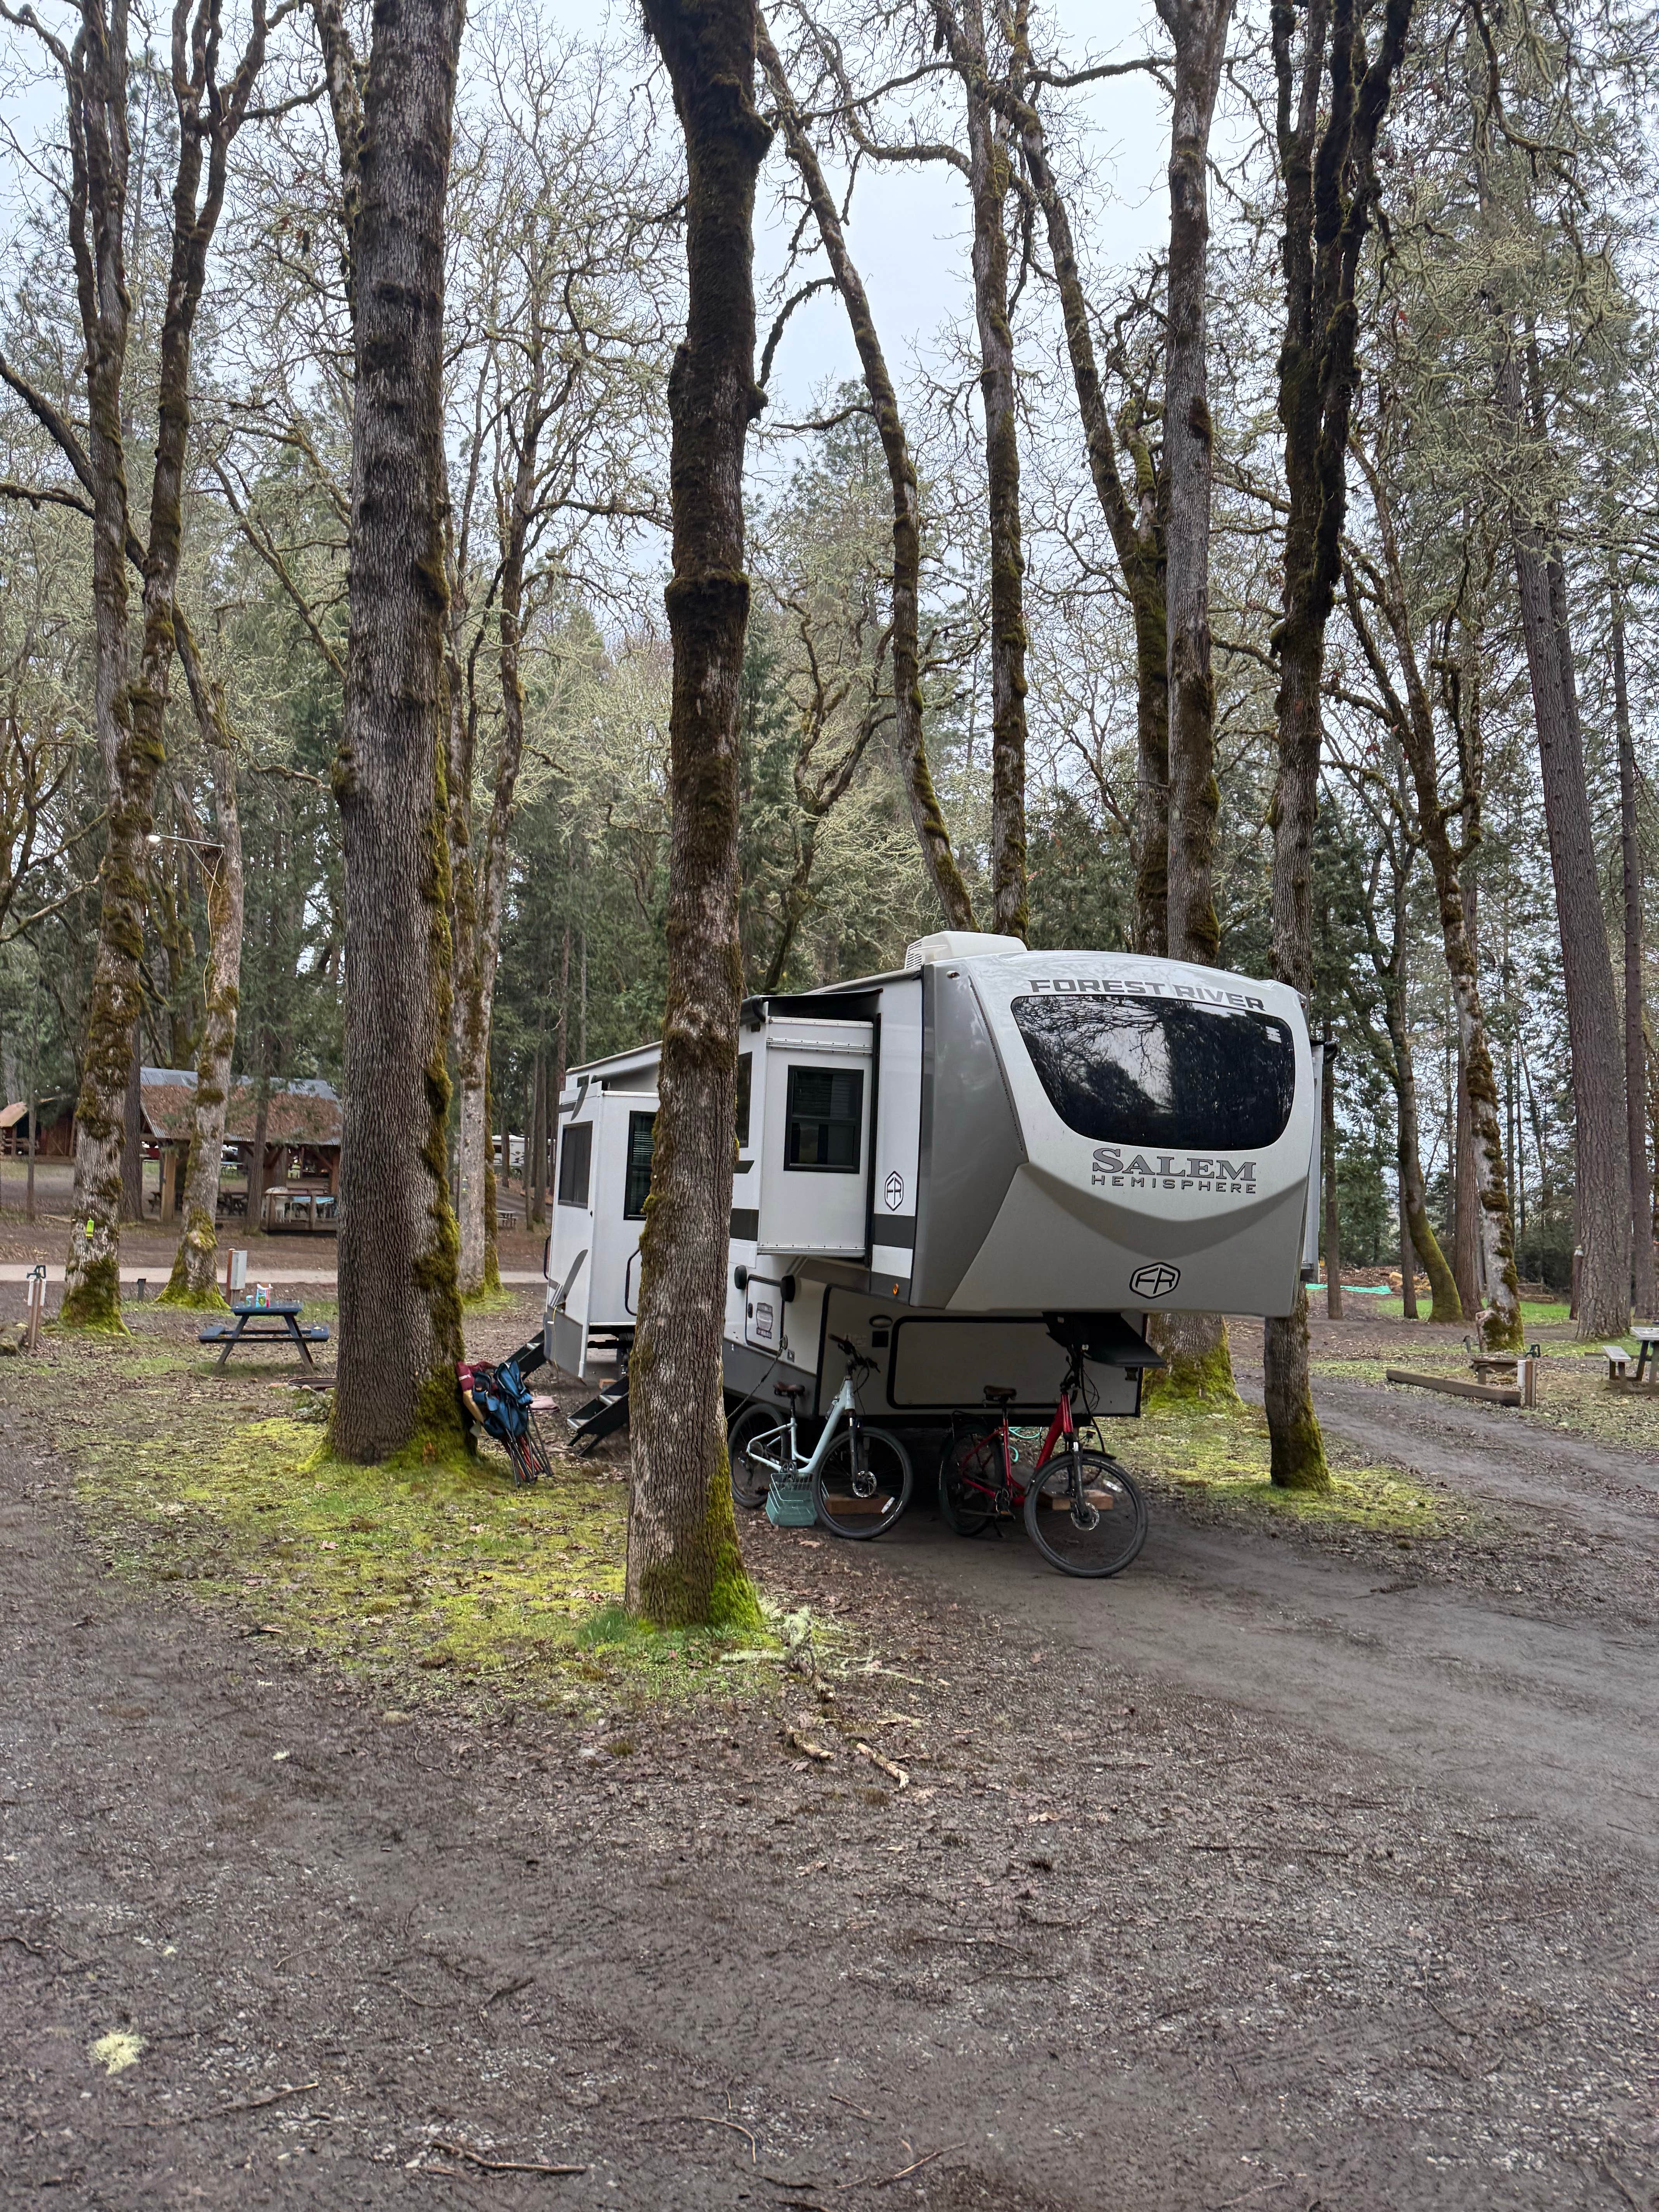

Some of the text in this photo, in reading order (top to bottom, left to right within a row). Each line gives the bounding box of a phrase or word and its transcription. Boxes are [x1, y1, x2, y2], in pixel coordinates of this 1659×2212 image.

[1027, 979, 1266, 1011] FOREST RIVER
[1092, 1147, 1256, 1181] SALEM
[1092, 1175, 1256, 1194] HEMISPHERE
